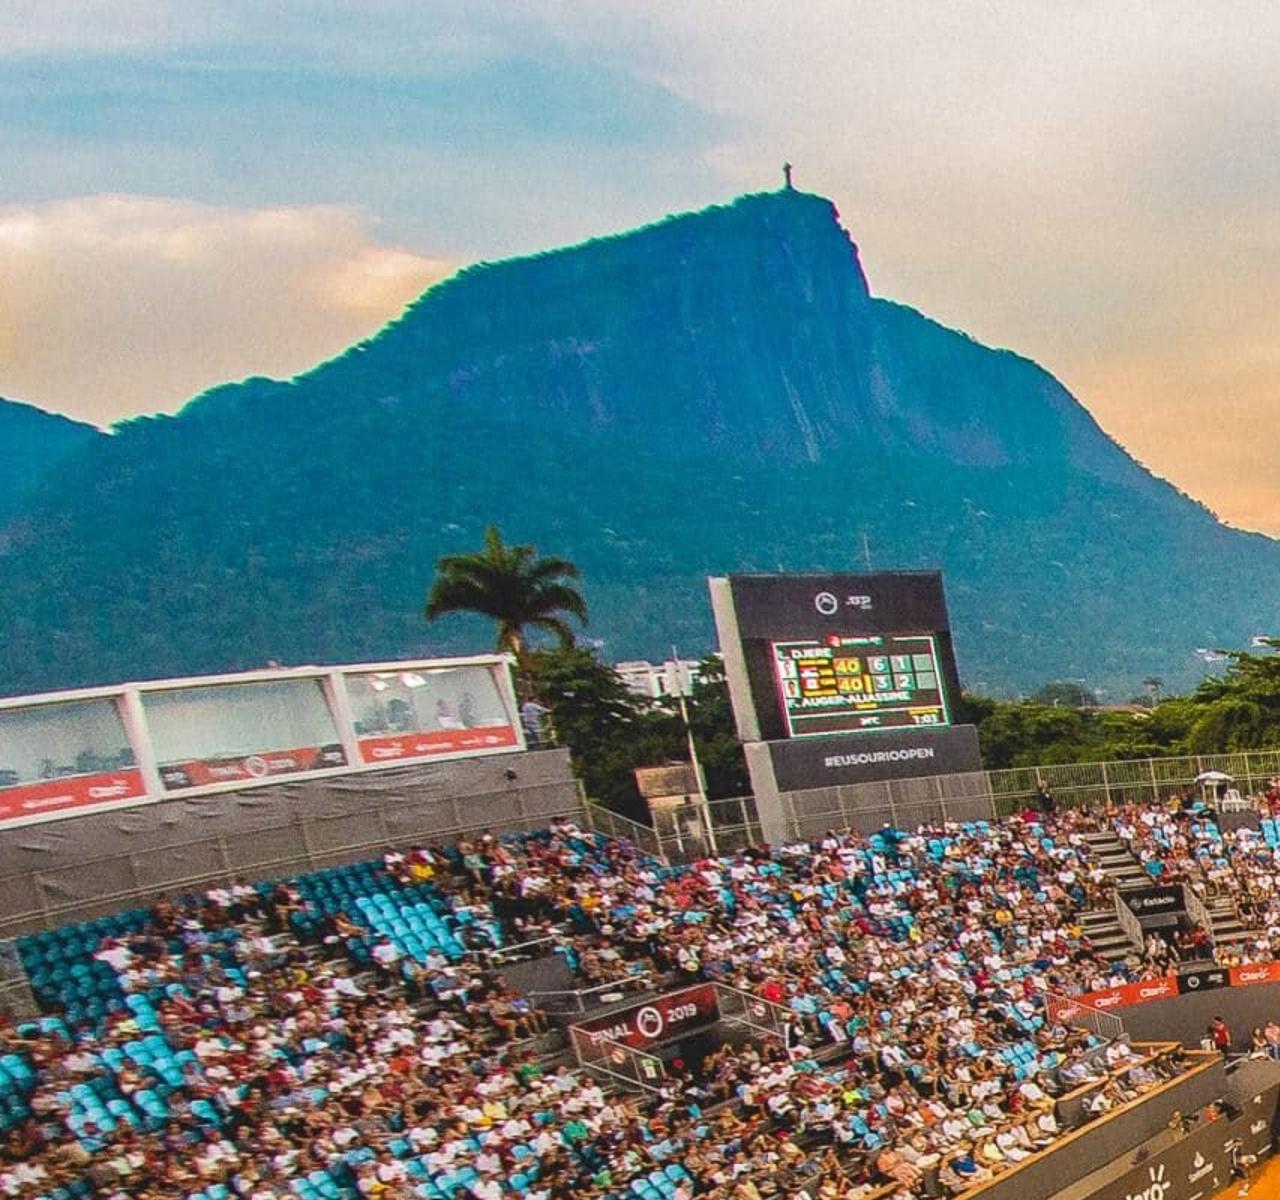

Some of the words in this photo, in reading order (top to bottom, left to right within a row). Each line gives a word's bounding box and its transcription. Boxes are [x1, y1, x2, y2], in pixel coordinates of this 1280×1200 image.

[791, 648, 833, 659] DJERE
[838, 660, 861, 671] 40
[874, 660, 884, 670] 6
[842, 679, 865, 691] 40
[878, 678, 889, 689] 3
[900, 676, 911, 688] 2
[825, 747, 934, 768] #EUSOURIOOPEN
[1239, 966, 1269, 981] Claro
[1139, 982, 1168, 998] Claro
[590, 1023, 635, 1045] FINAL
[667, 1003, 696, 1022] 2019
